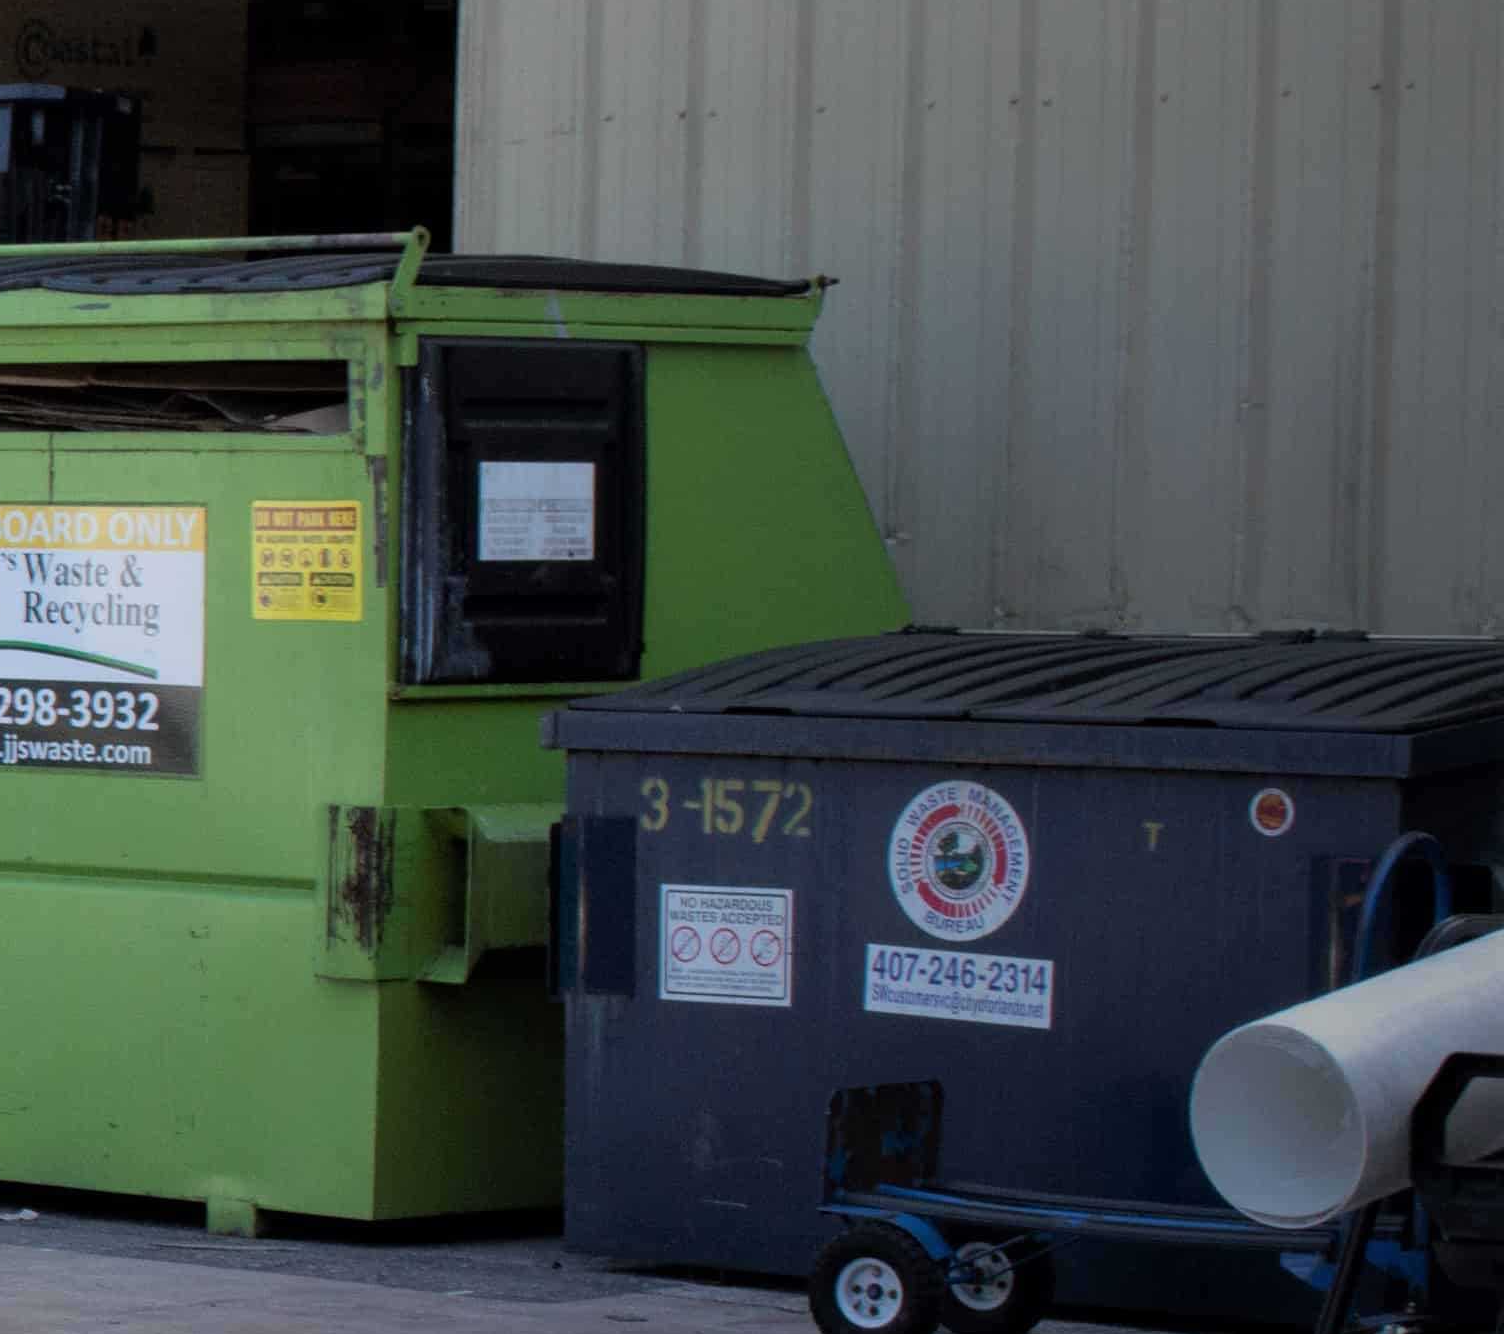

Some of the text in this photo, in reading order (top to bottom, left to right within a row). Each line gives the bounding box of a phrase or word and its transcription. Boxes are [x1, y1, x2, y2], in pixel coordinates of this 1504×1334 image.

[108, 510, 198, 546] ONLY
[23, 553, 110, 587] Waste
[120, 555, 144, 588] &
[24, 590, 161, 635] Recycling
[895, 786, 1024, 906] SOLID WASTE MANAGEMENT
[670, 910, 785, 927] WASTES ACCEPTED
[679, 896, 774, 913] NO HAZARDOUS
[925, 911, 985, 934] BUREAU
[871, 949, 1047, 996] 407-246-2314
